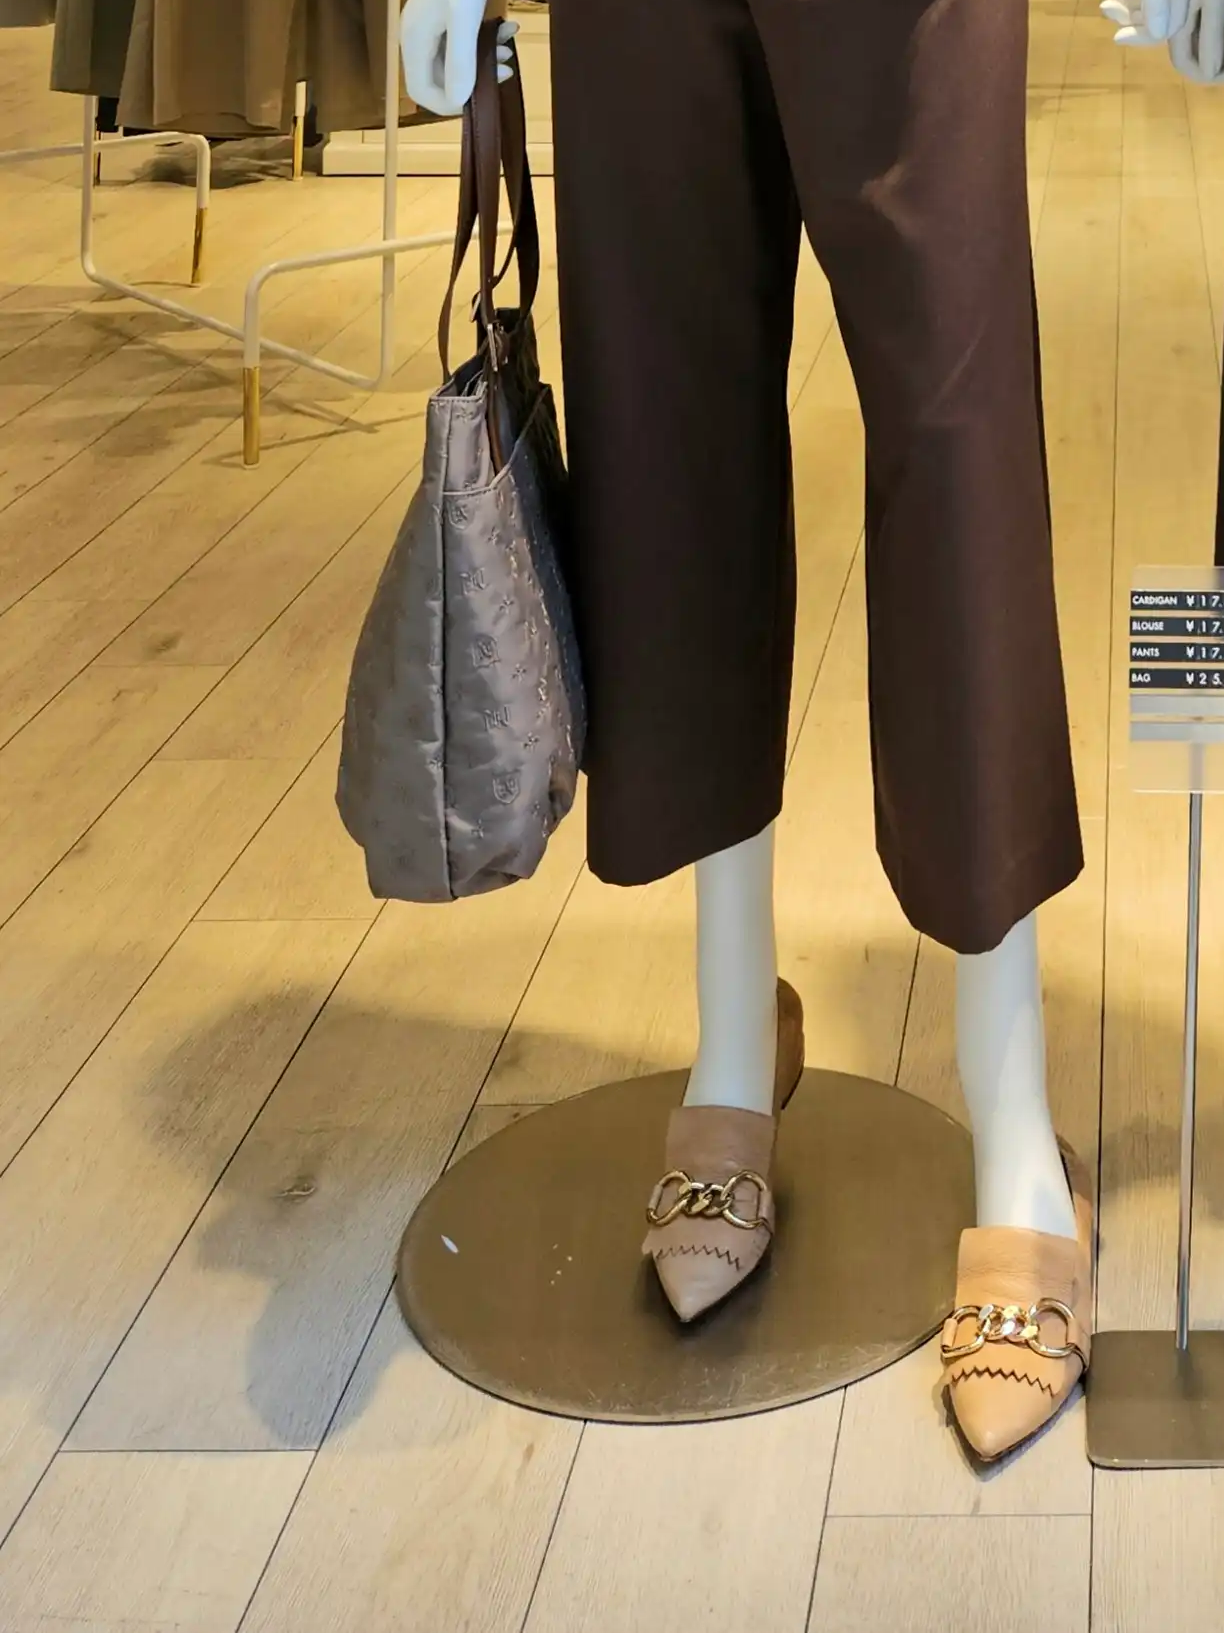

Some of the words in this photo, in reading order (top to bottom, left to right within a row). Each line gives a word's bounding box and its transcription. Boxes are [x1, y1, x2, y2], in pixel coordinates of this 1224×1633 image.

[1132, 621, 1165, 631] BLOUSE
[1132, 647, 1160, 657] PANTS
[1131, 672, 1151, 683] BAG
